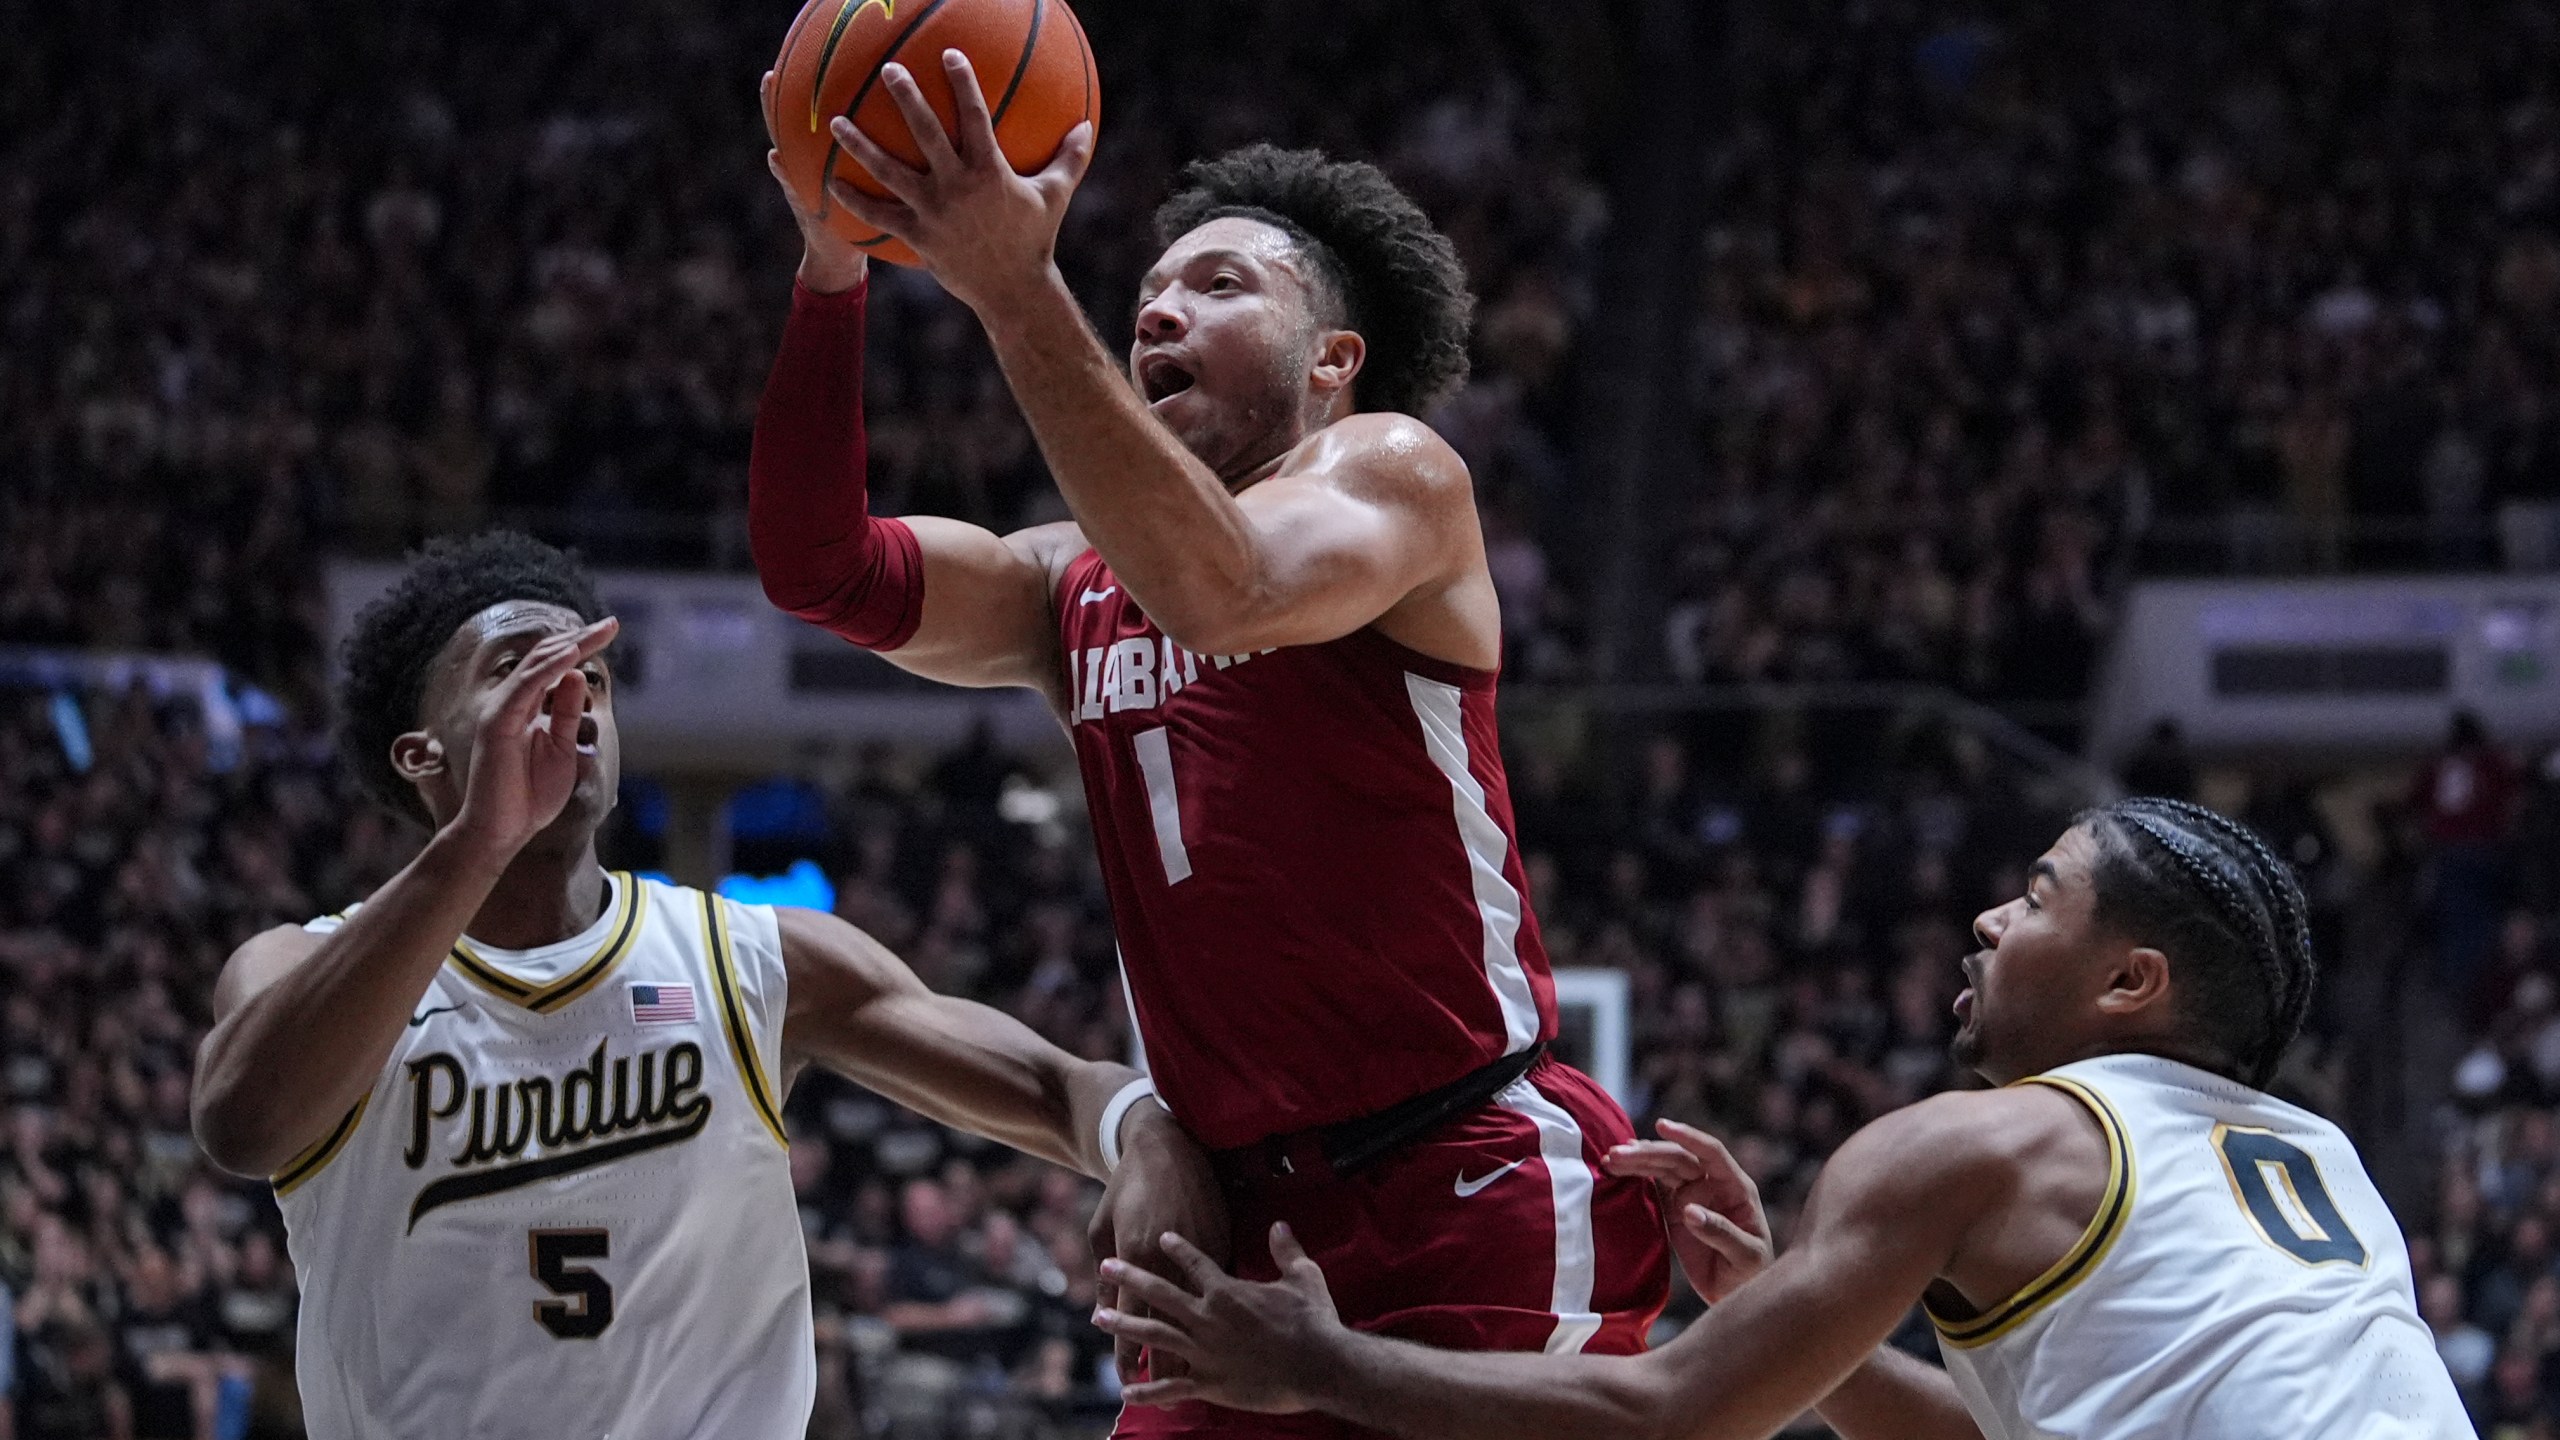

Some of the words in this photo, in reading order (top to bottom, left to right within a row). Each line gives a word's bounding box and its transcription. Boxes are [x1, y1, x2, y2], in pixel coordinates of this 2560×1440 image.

[1133, 726, 1193, 887] 1
[403, 1036, 712, 1170] Purdue
[2208, 1122, 2371, 1272] 0
[528, 1227, 615, 1340] 5
